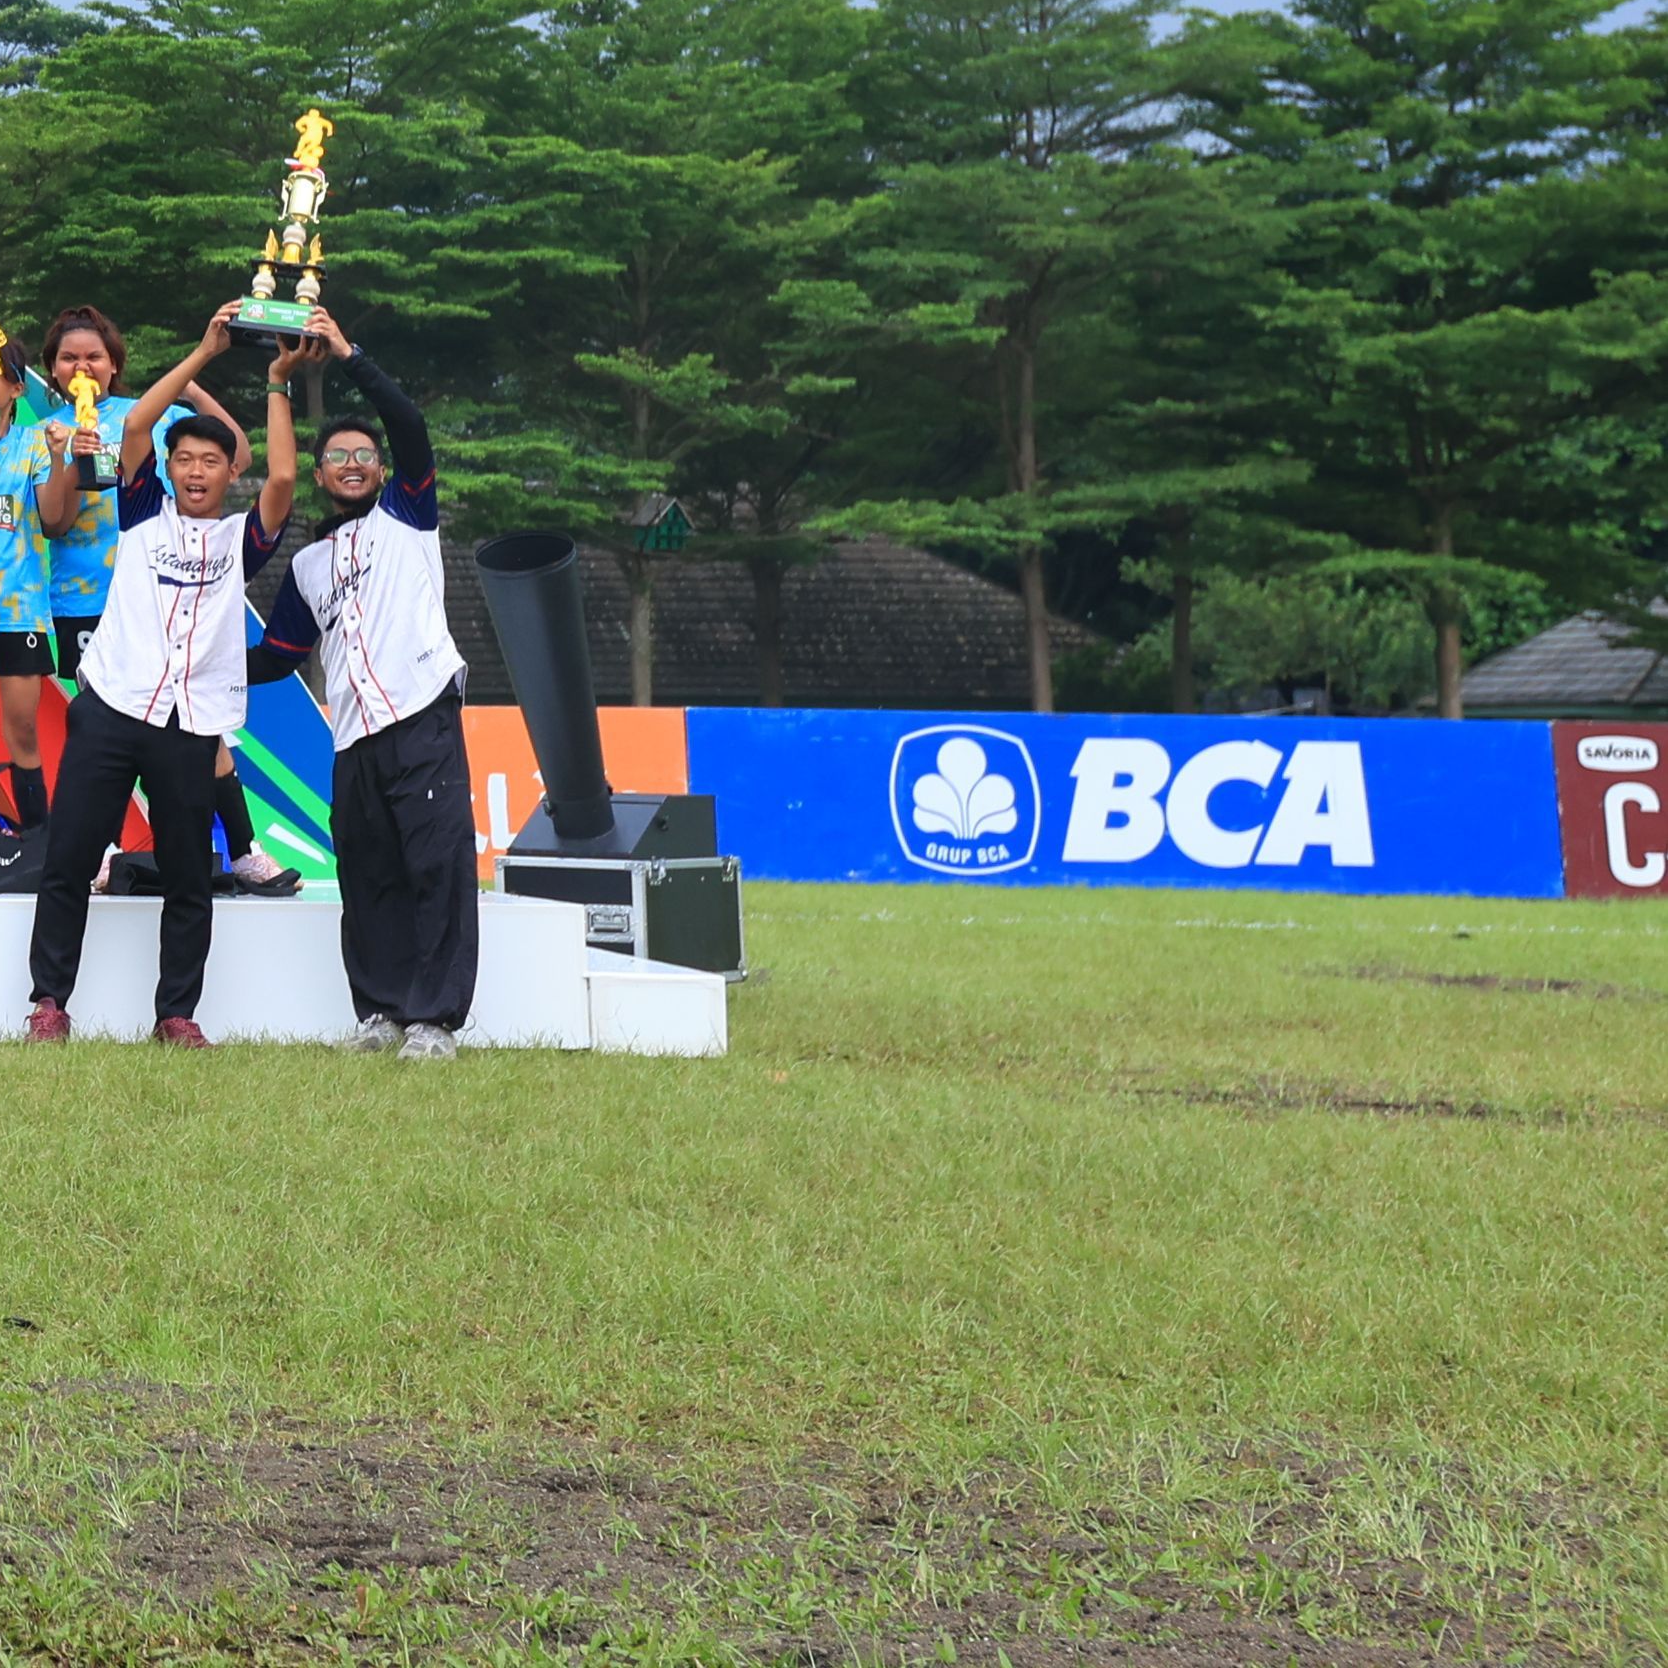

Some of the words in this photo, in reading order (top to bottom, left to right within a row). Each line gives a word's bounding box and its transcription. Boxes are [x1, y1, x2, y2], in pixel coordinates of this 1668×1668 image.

[1584, 743, 1652, 760] SAVORIA
[1062, 738, 1375, 868] BCA
[926, 842, 971, 865] GRUP
[976, 844, 1010, 866] BCA
